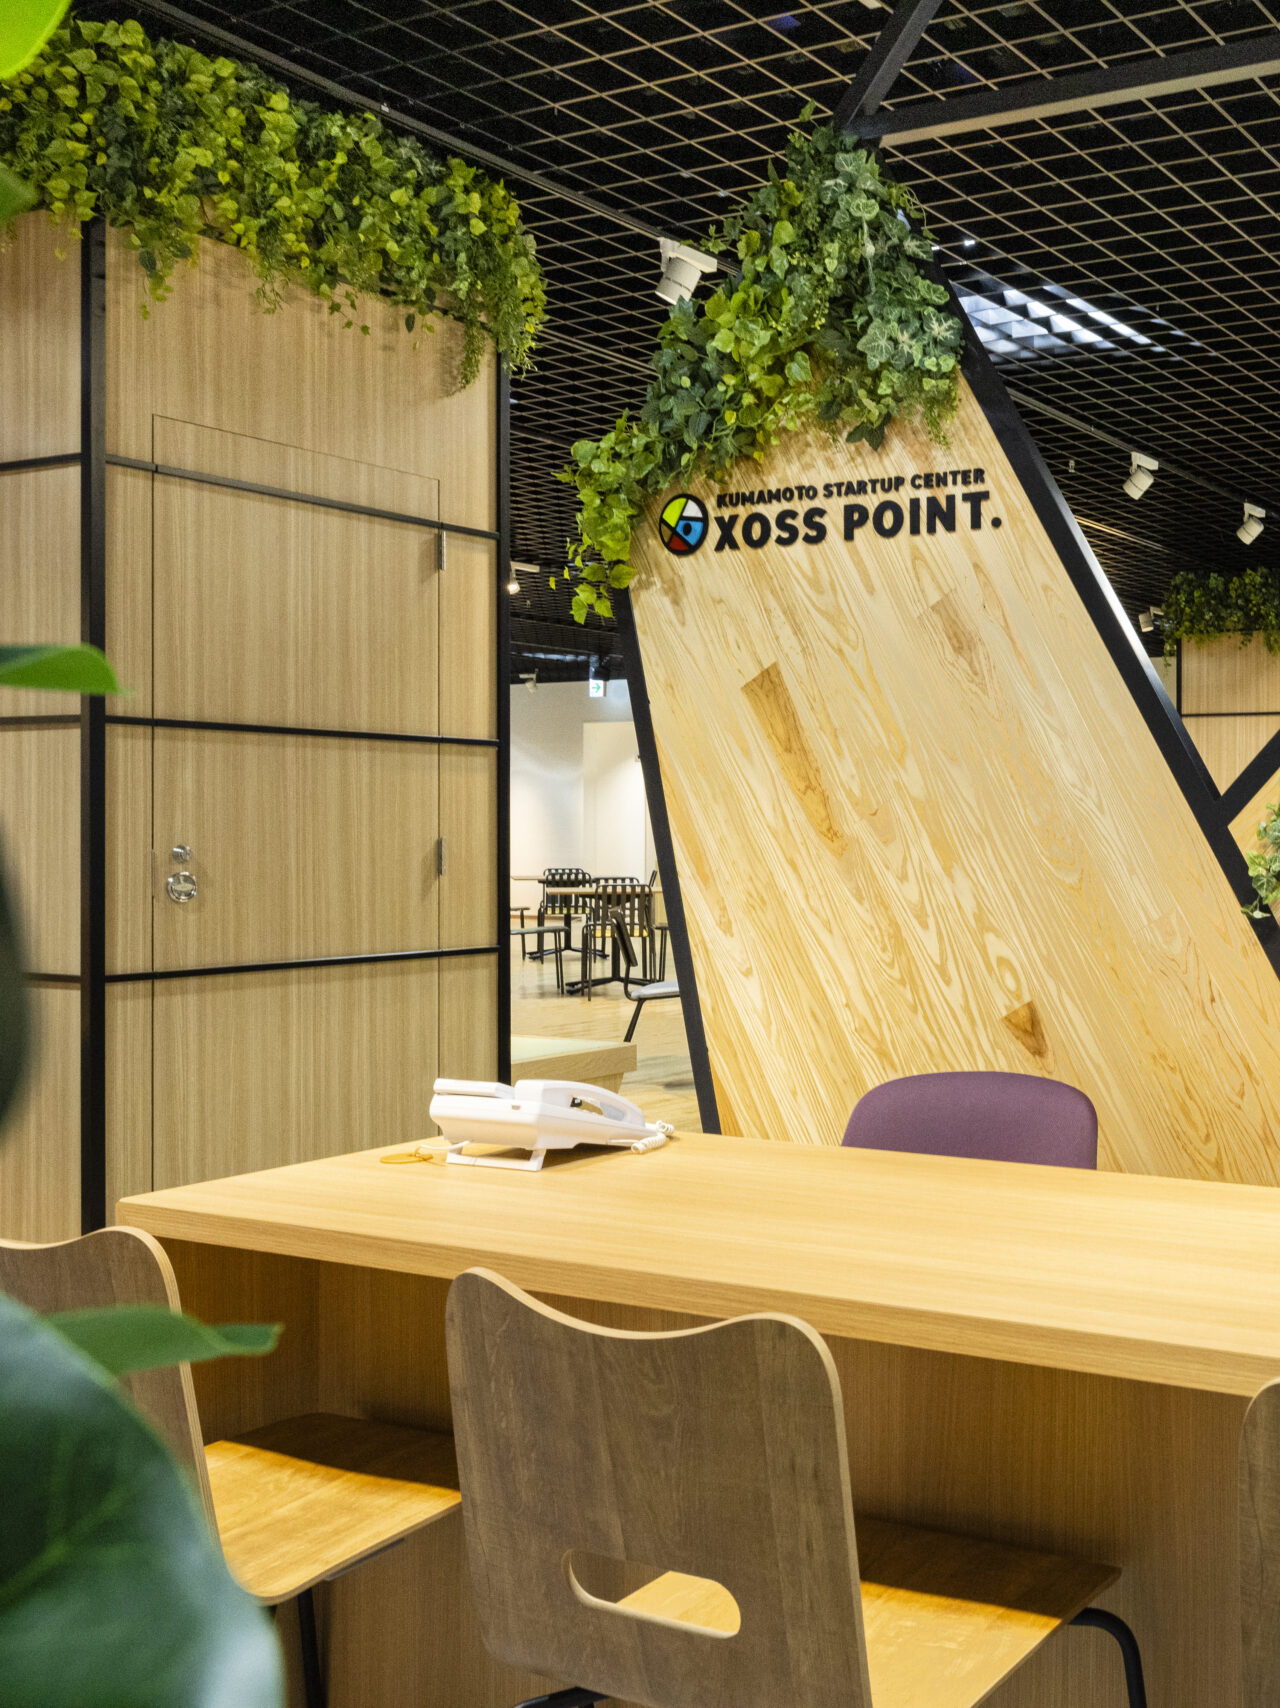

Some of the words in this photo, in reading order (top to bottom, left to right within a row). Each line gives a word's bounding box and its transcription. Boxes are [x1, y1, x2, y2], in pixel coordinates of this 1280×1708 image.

[716, 485, 818, 508] KUMAMOTO
[822, 475, 905, 498] STARTUP
[910, 468, 986, 489] CENTER
[714, 506, 828, 552] XOSS
[843, 490, 1003, 541] POINT.
